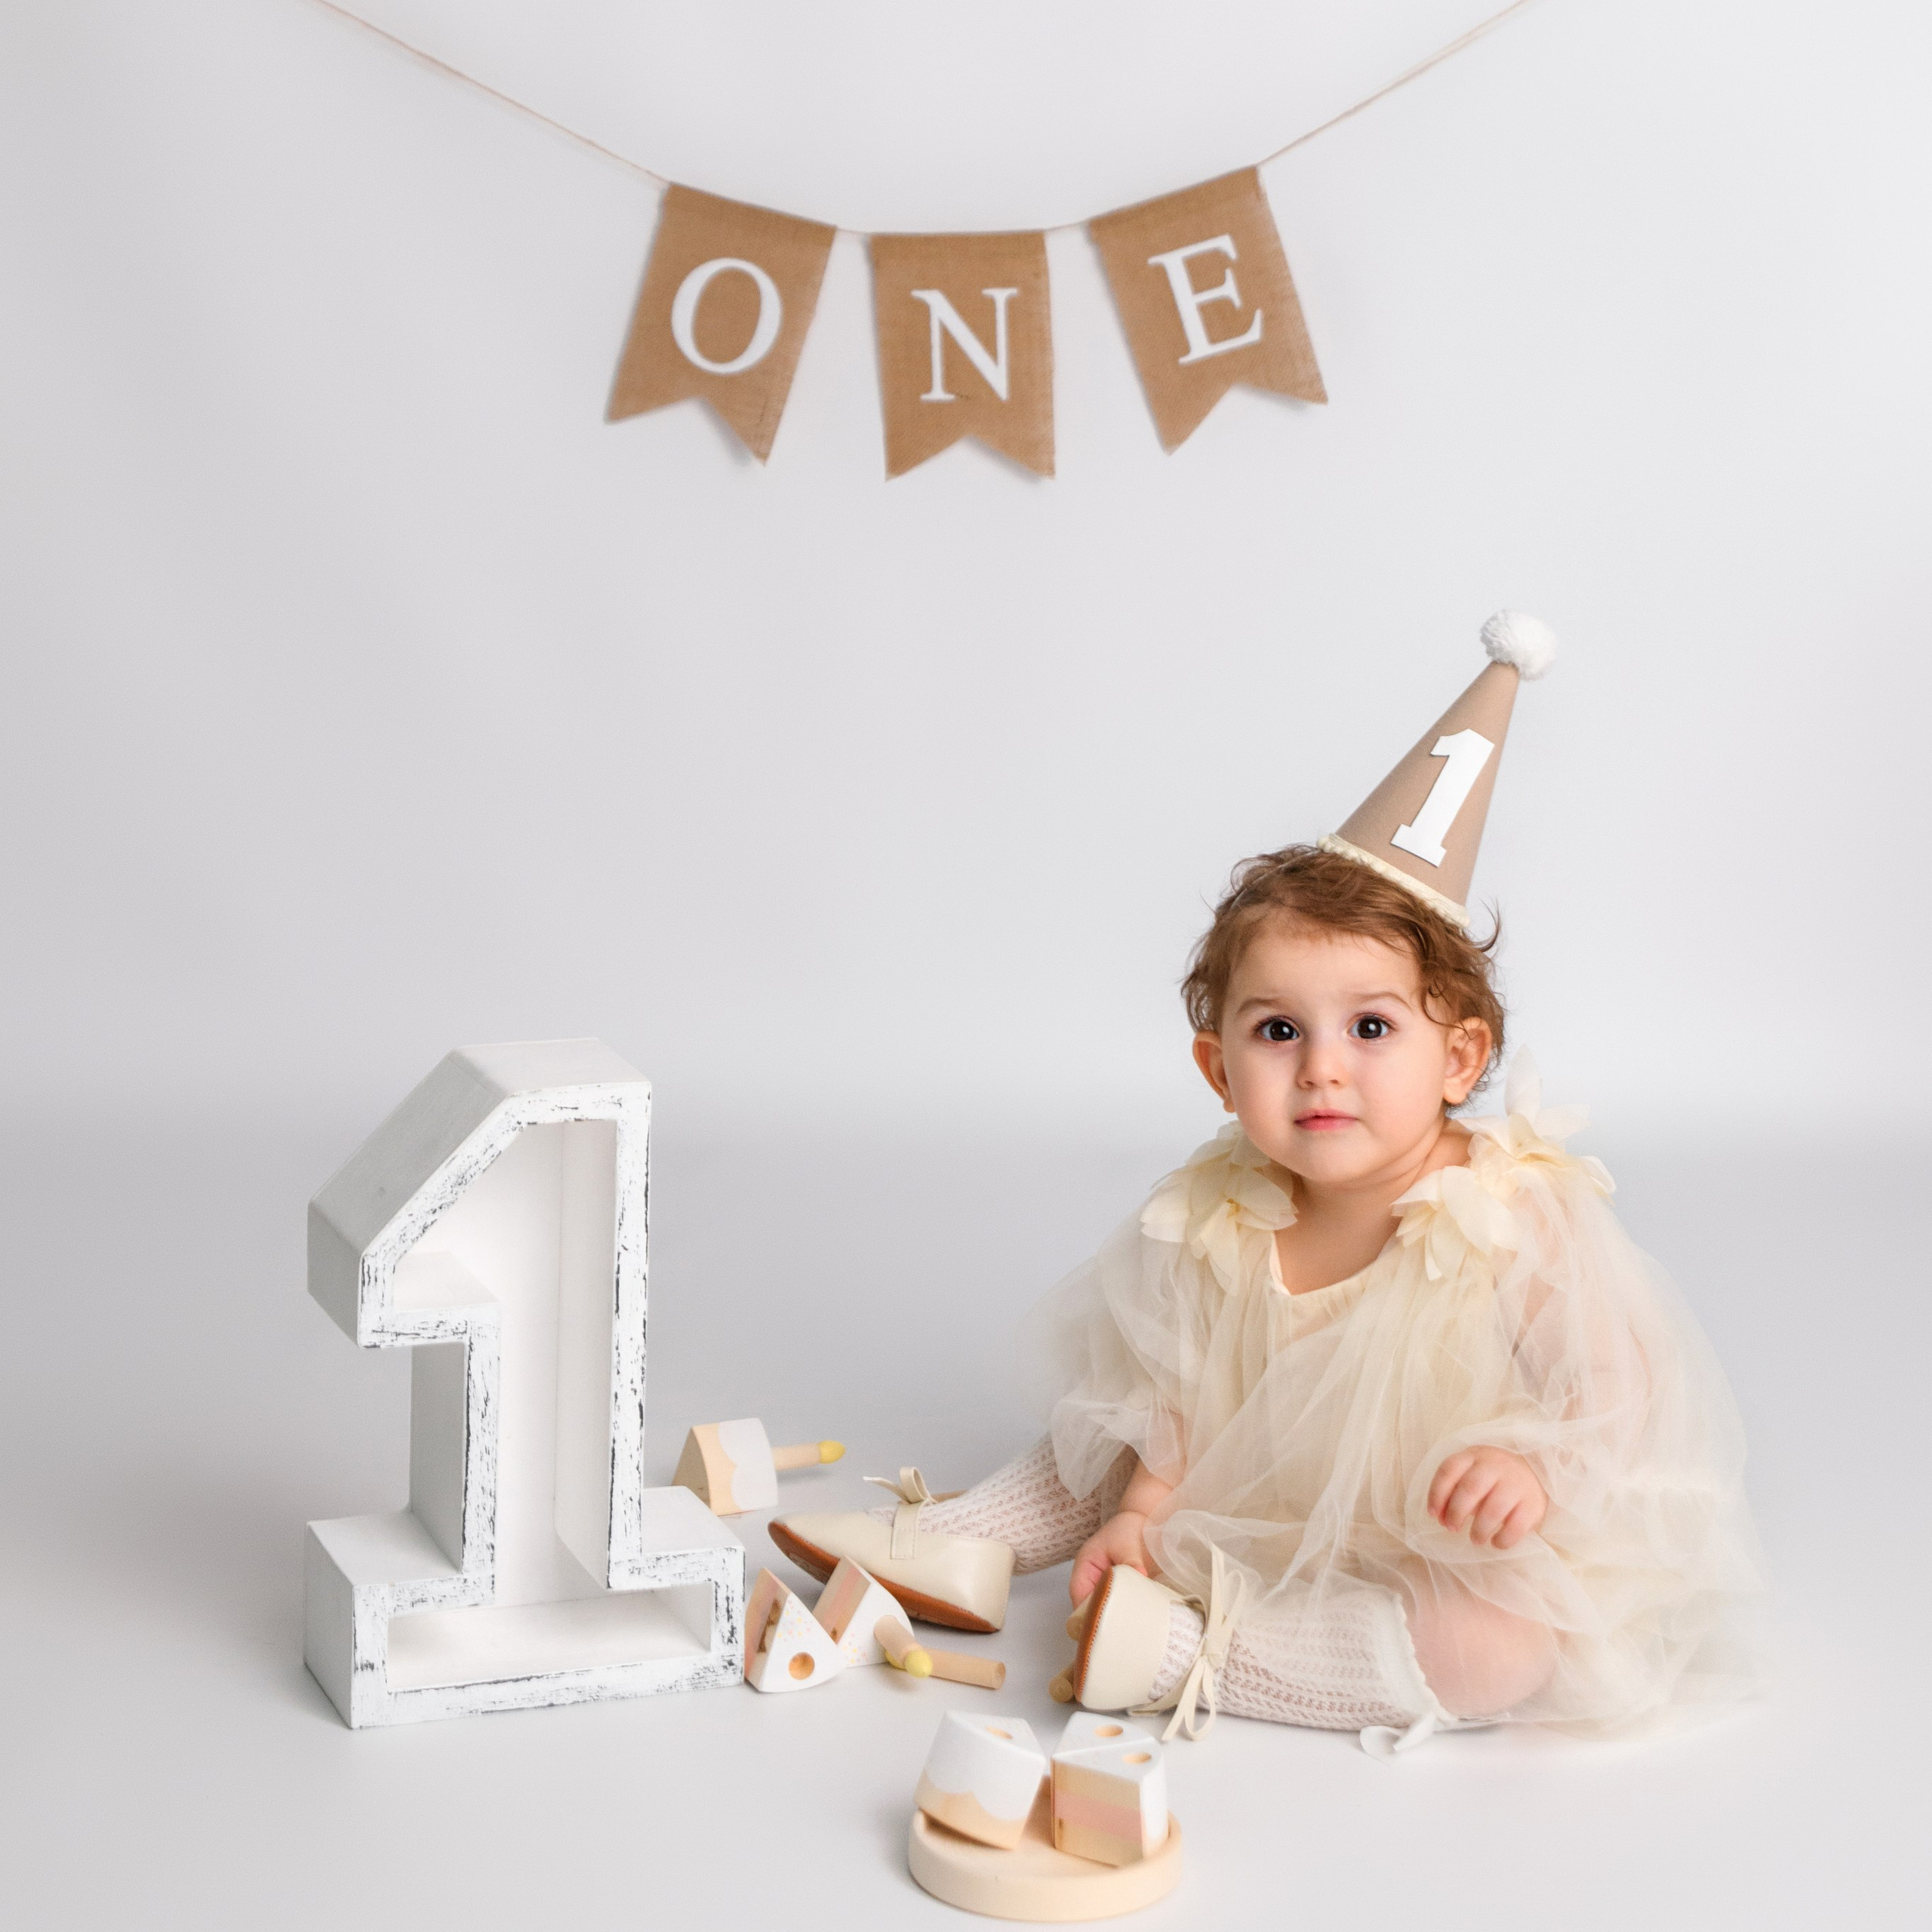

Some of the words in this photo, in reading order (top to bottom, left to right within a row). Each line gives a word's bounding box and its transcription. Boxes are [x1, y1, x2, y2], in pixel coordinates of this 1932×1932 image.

[671, 234, 1263, 401] ONE
[1390, 728, 1495, 868] 1
[306, 1037, 746, 1730] 1
